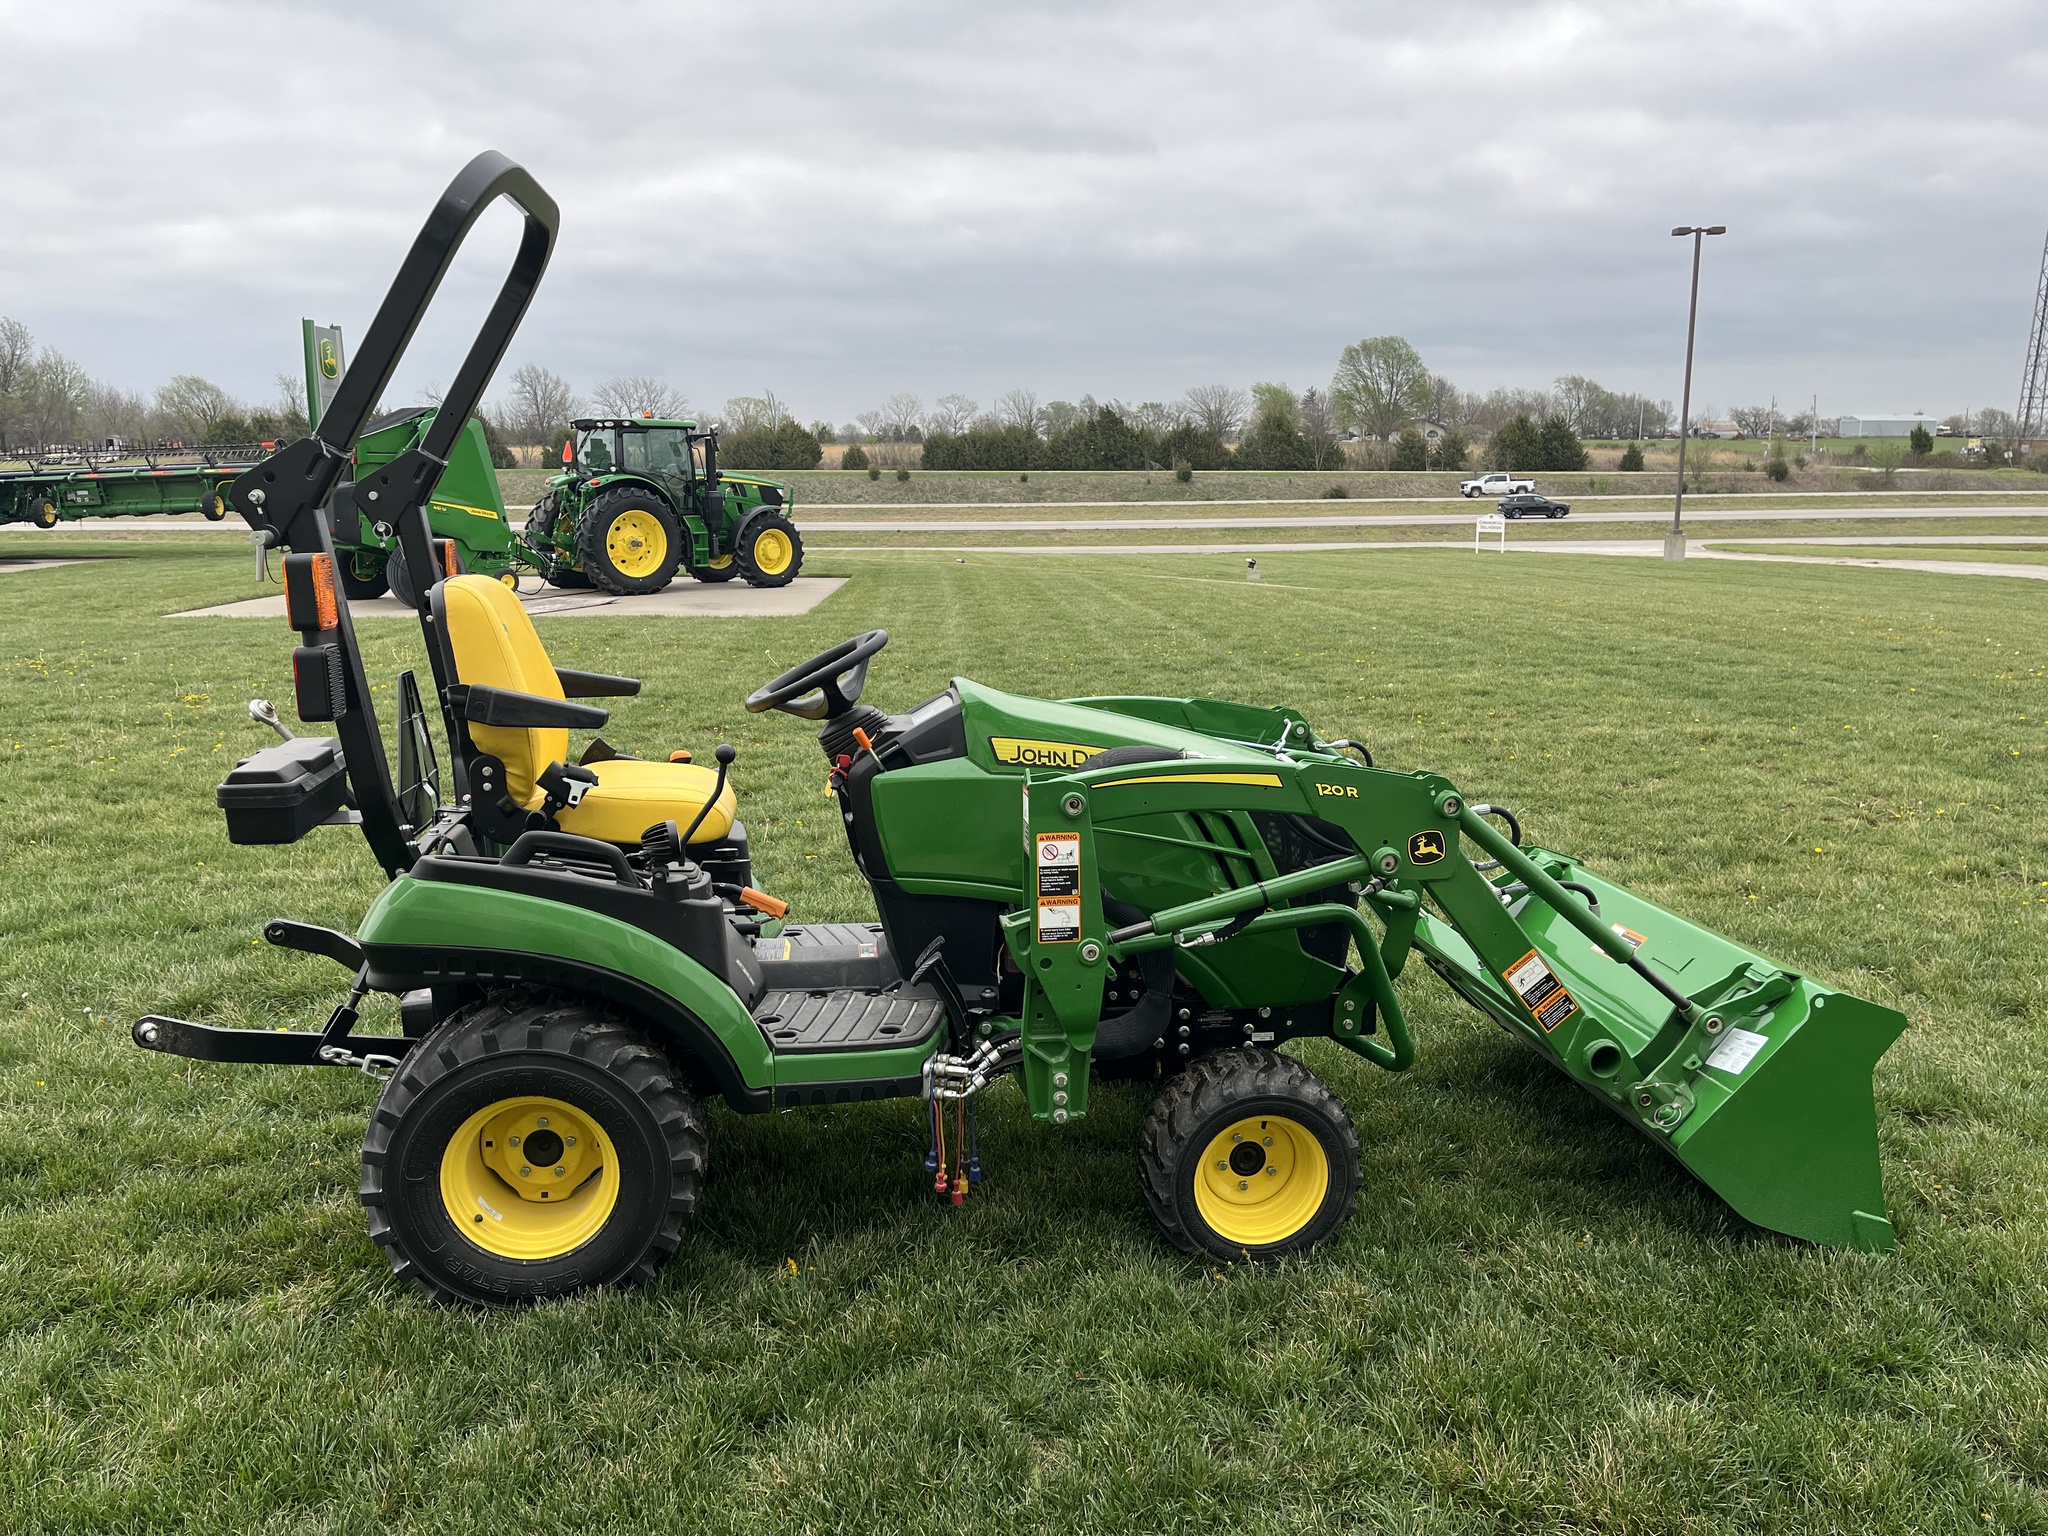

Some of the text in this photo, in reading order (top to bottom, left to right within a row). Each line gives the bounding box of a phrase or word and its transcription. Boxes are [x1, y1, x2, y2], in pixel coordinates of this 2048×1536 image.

[1009, 745, 1096, 766] JOHN D
[1045, 833, 1078, 841] WARNING
[1046, 899, 1079, 907] WARNING
[1512, 953, 1534, 971] WARNING
[1543, 991, 1564, 1010] WARNING
[443, 1253, 583, 1295] CARLSTAR
